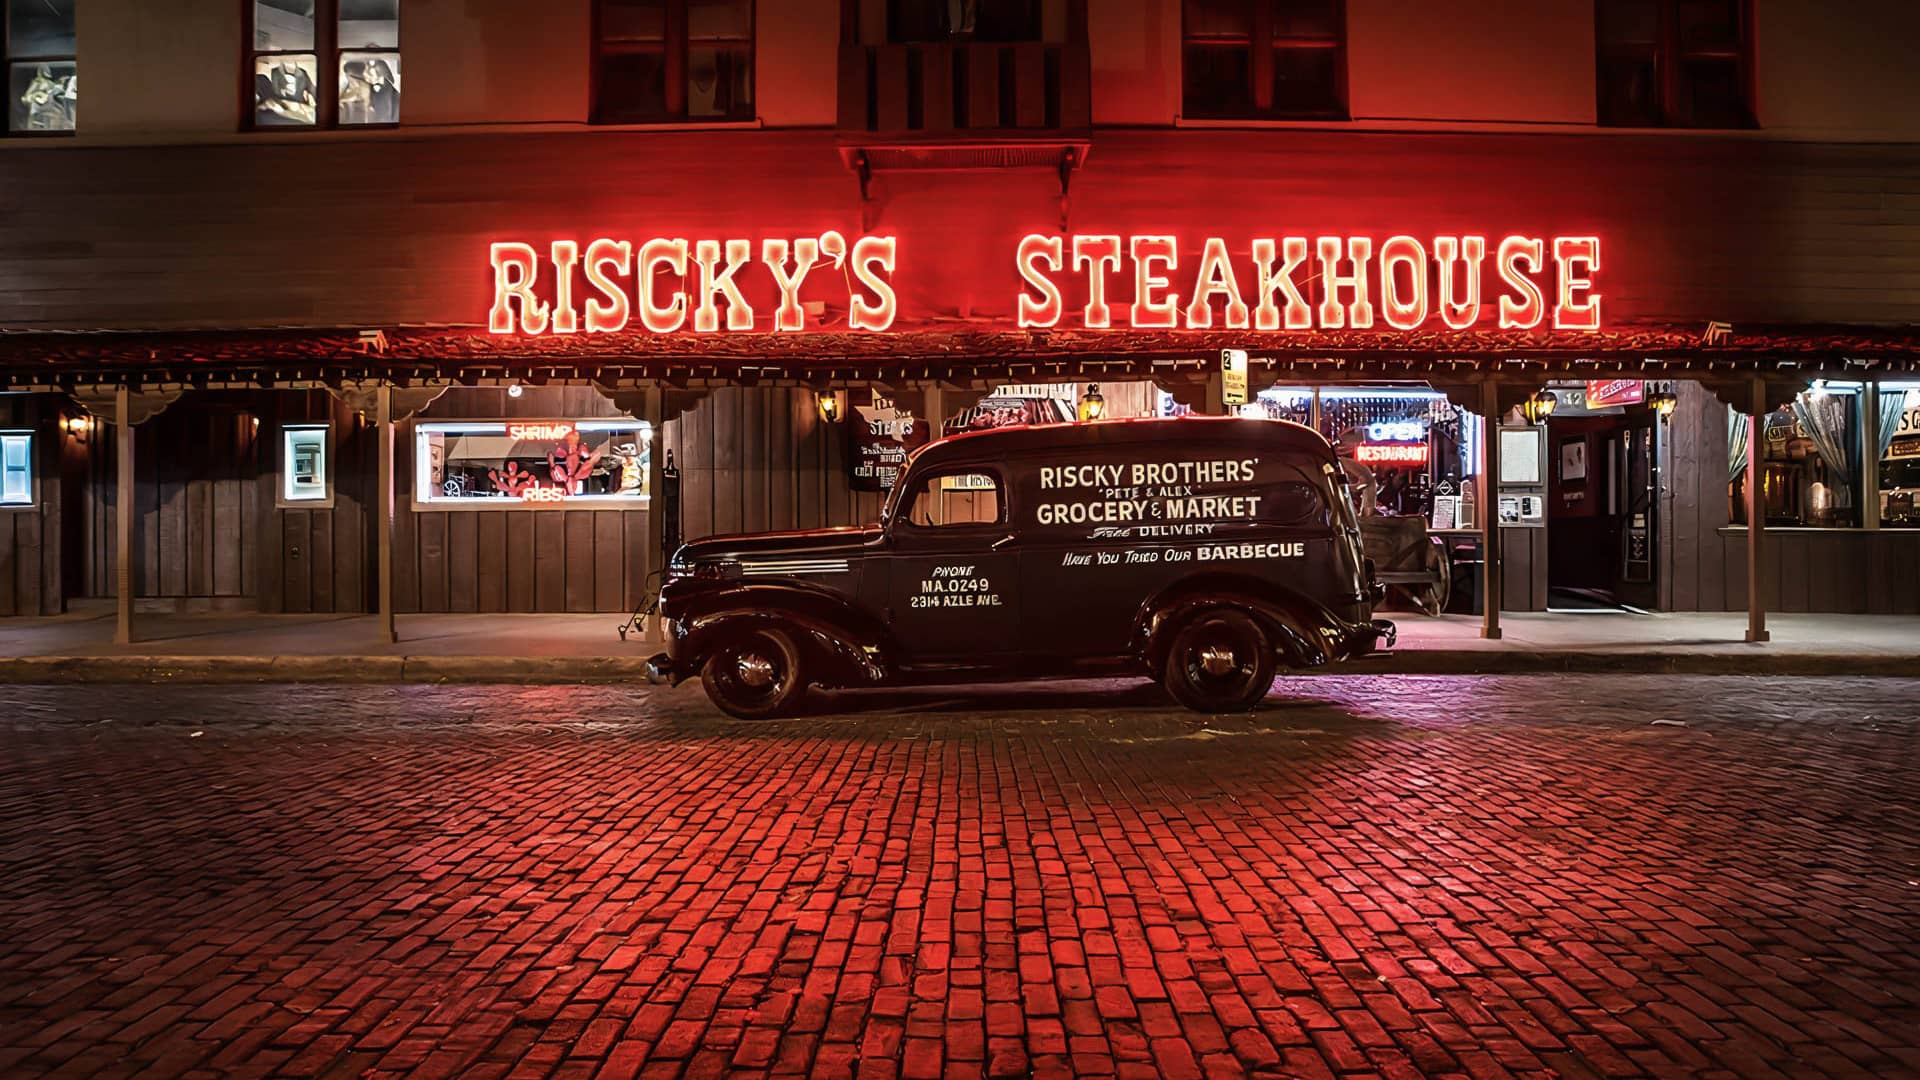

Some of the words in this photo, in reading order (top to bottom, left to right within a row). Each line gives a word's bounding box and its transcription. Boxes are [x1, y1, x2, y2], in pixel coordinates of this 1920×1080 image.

[488, 230, 897, 335] RISCKY'S
[1016, 233, 1602, 331] STEAKHOUSE
[509, 424, 573, 441] SHRIMP
[1369, 421, 1423, 441] OPEN
[1357, 446, 1428, 462] RESTAURANT
[1040, 465, 1124, 489] RISCKY
[1036, 500, 1148, 525] GROCERY
[1151, 501, 1162, 519] &
[1166, 496, 1261, 520] MARKET
[1139, 523, 1215, 537] DELIVERY
[1197, 543, 1305, 561] BARBECUE
[943, 594, 974, 607] AZLE
